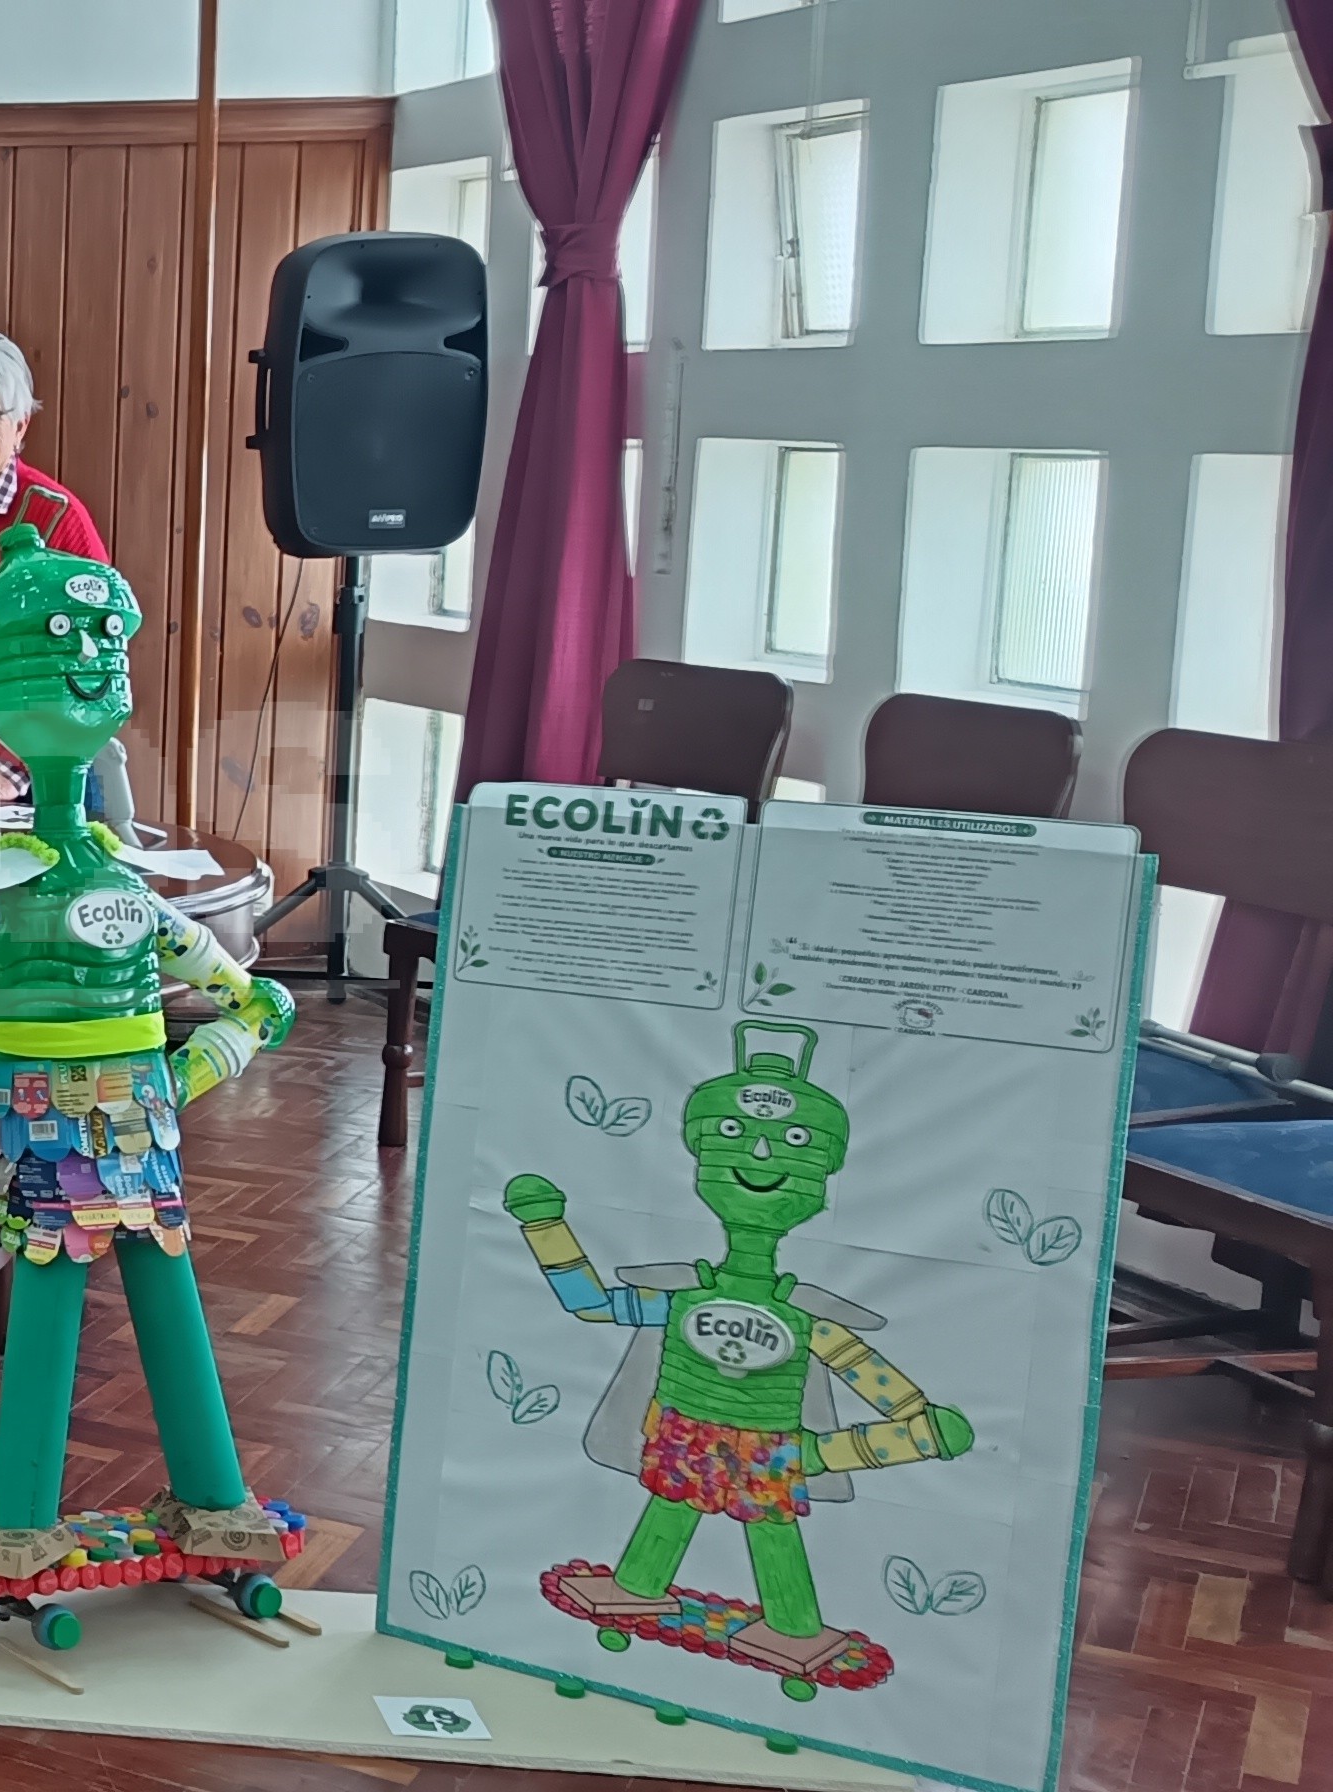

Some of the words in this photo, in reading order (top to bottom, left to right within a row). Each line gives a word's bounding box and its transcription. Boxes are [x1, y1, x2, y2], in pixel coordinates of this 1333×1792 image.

[882, 815, 950, 829] MATERIALES
[952, 820, 1017, 834] UTILIZADOS
[78, 898, 142, 928] Ecolin
[696, 1312, 779, 1351] Ecolin
